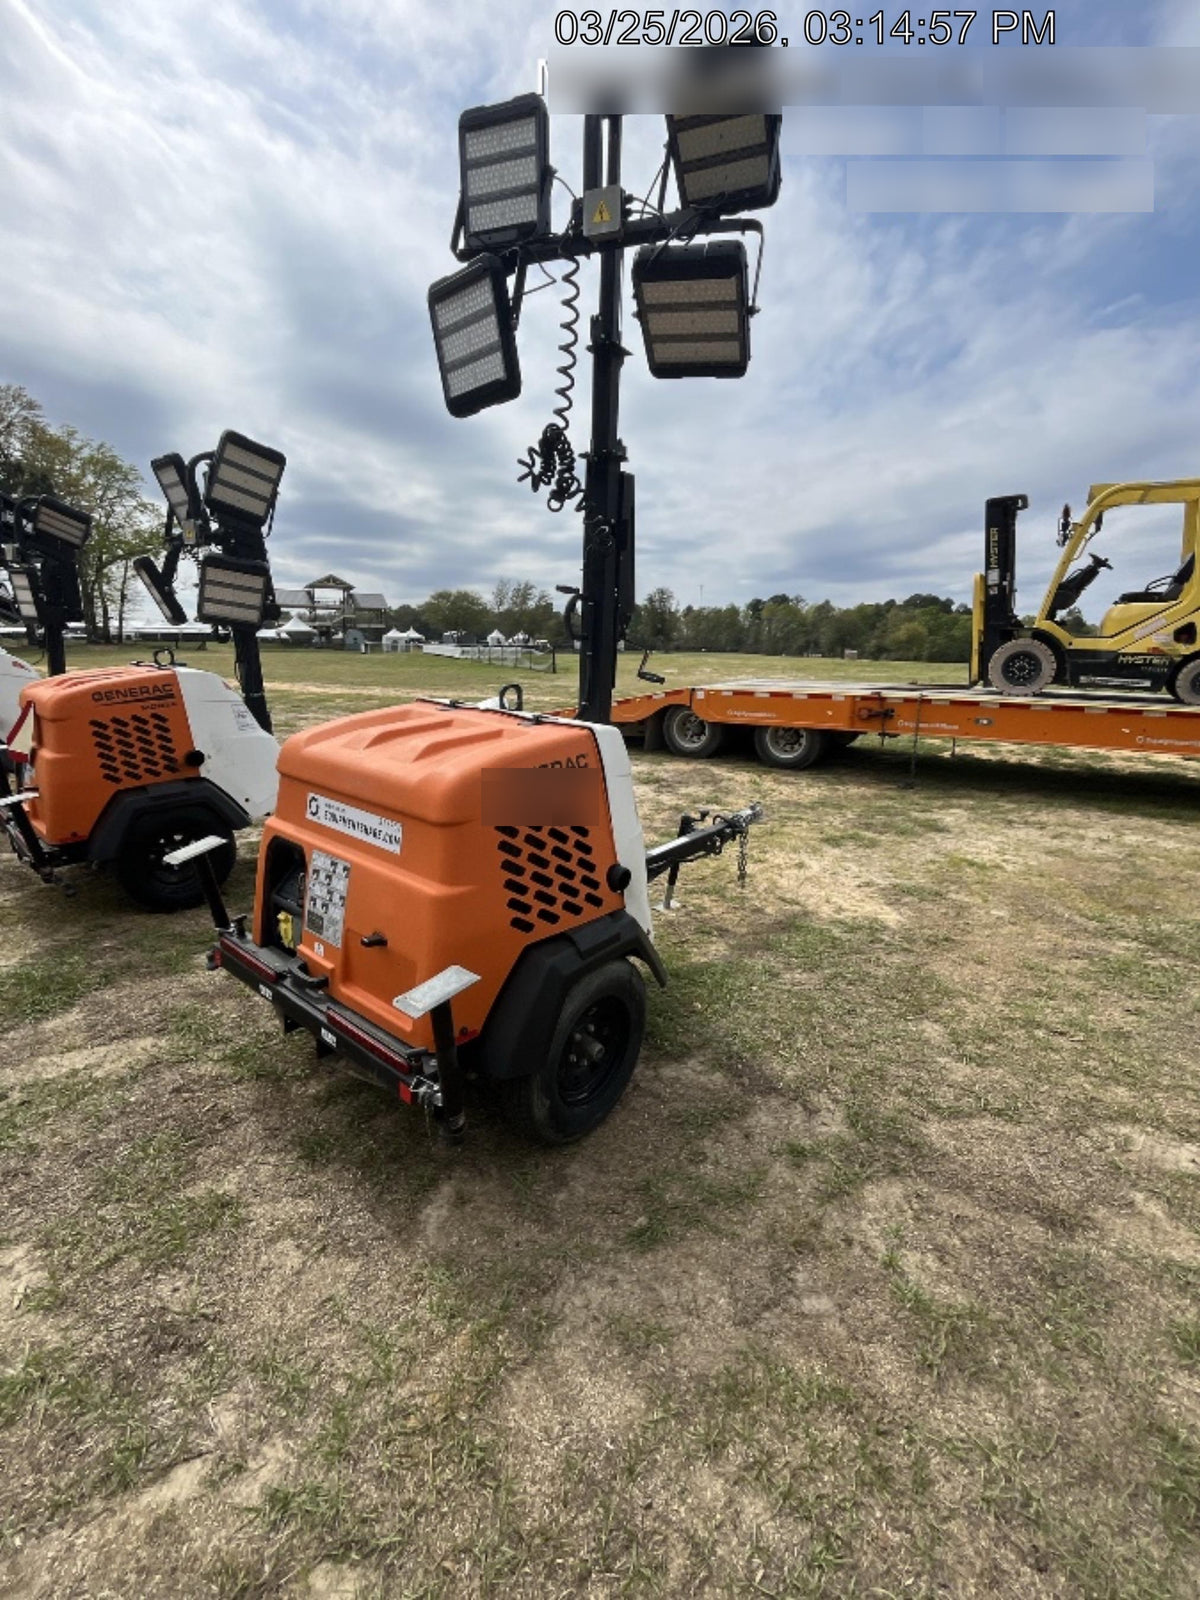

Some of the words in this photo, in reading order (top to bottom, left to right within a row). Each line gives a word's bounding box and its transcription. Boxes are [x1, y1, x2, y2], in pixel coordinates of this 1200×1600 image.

[988, 527, 999, 568] HYSTER
[1117, 655, 1170, 666] HYSTER
[91, 683, 174, 703] GENERAC
